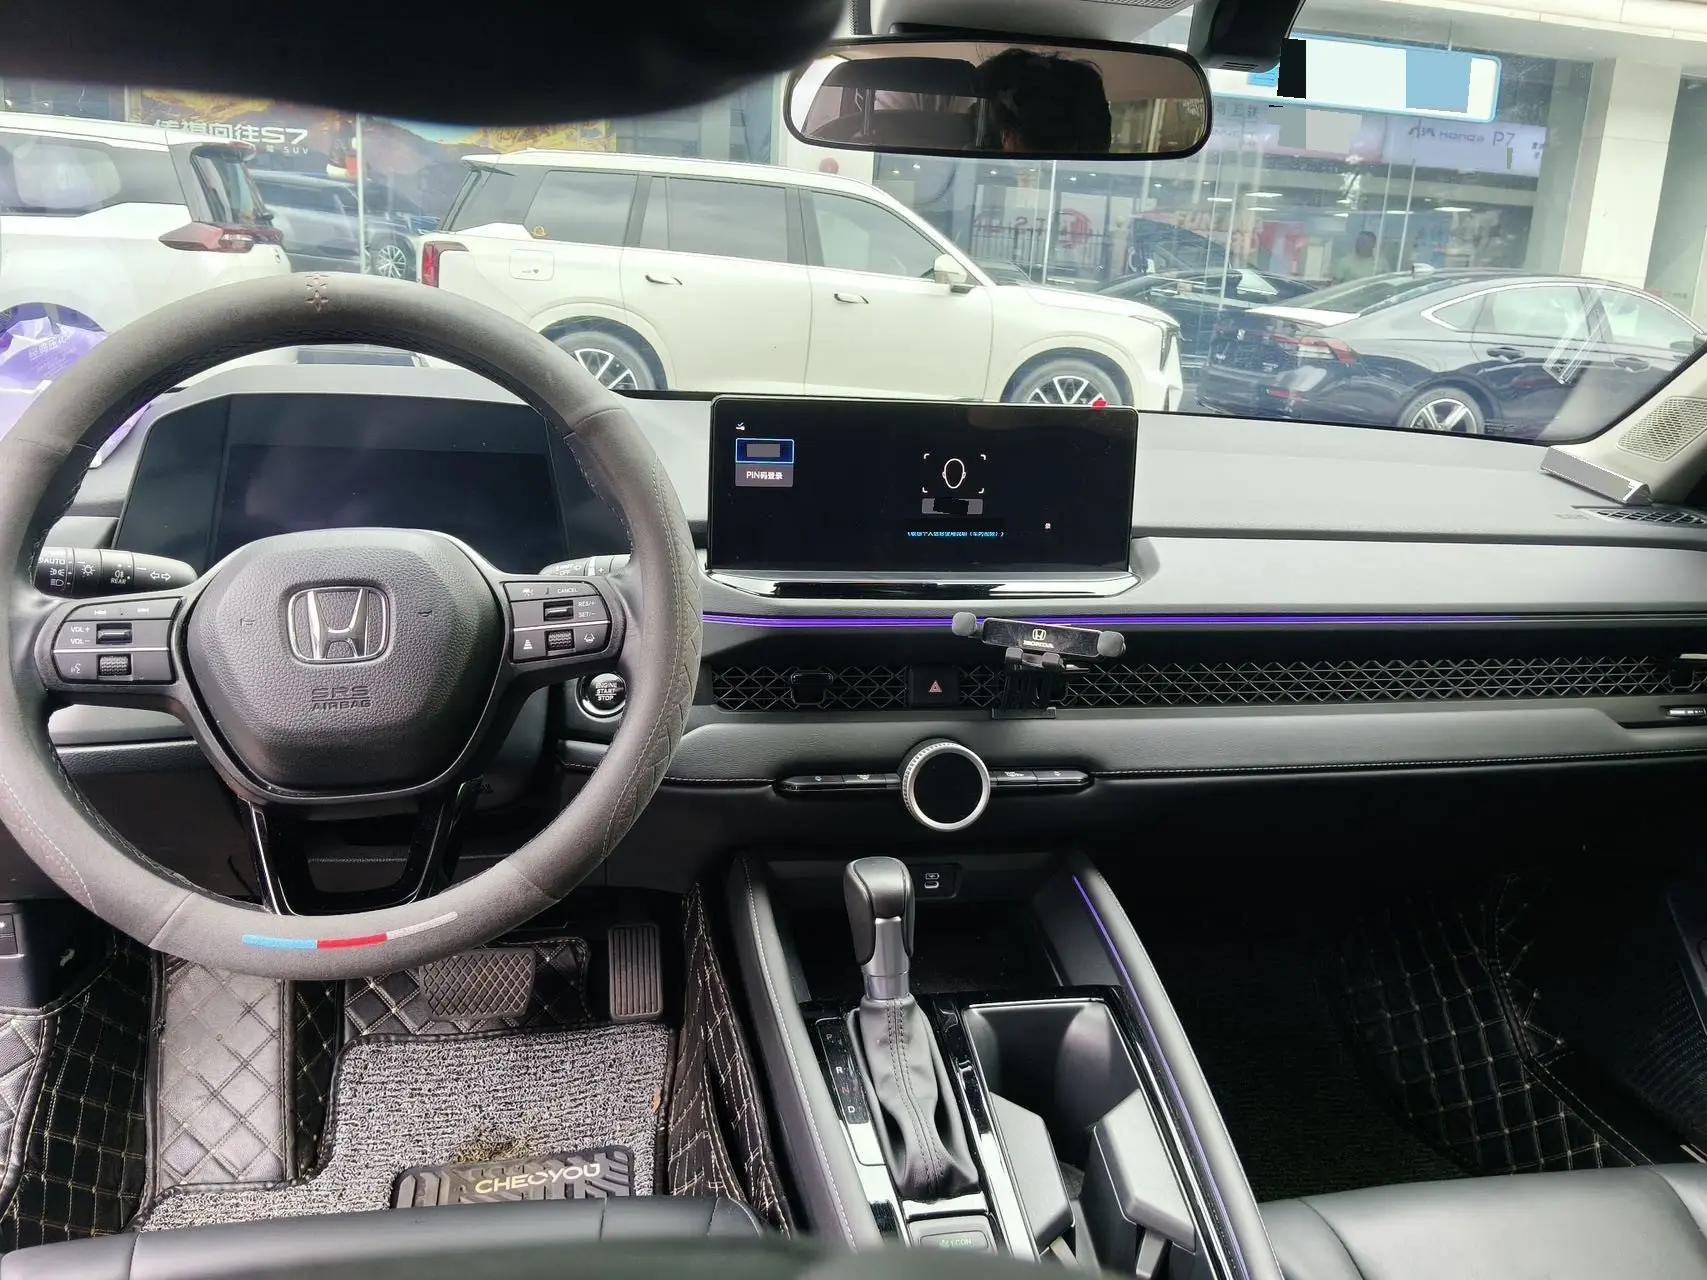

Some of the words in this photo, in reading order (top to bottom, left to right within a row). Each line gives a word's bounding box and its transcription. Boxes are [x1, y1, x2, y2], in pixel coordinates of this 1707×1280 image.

[312, 685, 369, 698] SRS
[312, 699, 371, 711] AIRBAG
[835, 1066, 843, 1074] R
[847, 1105, 856, 1113] D
